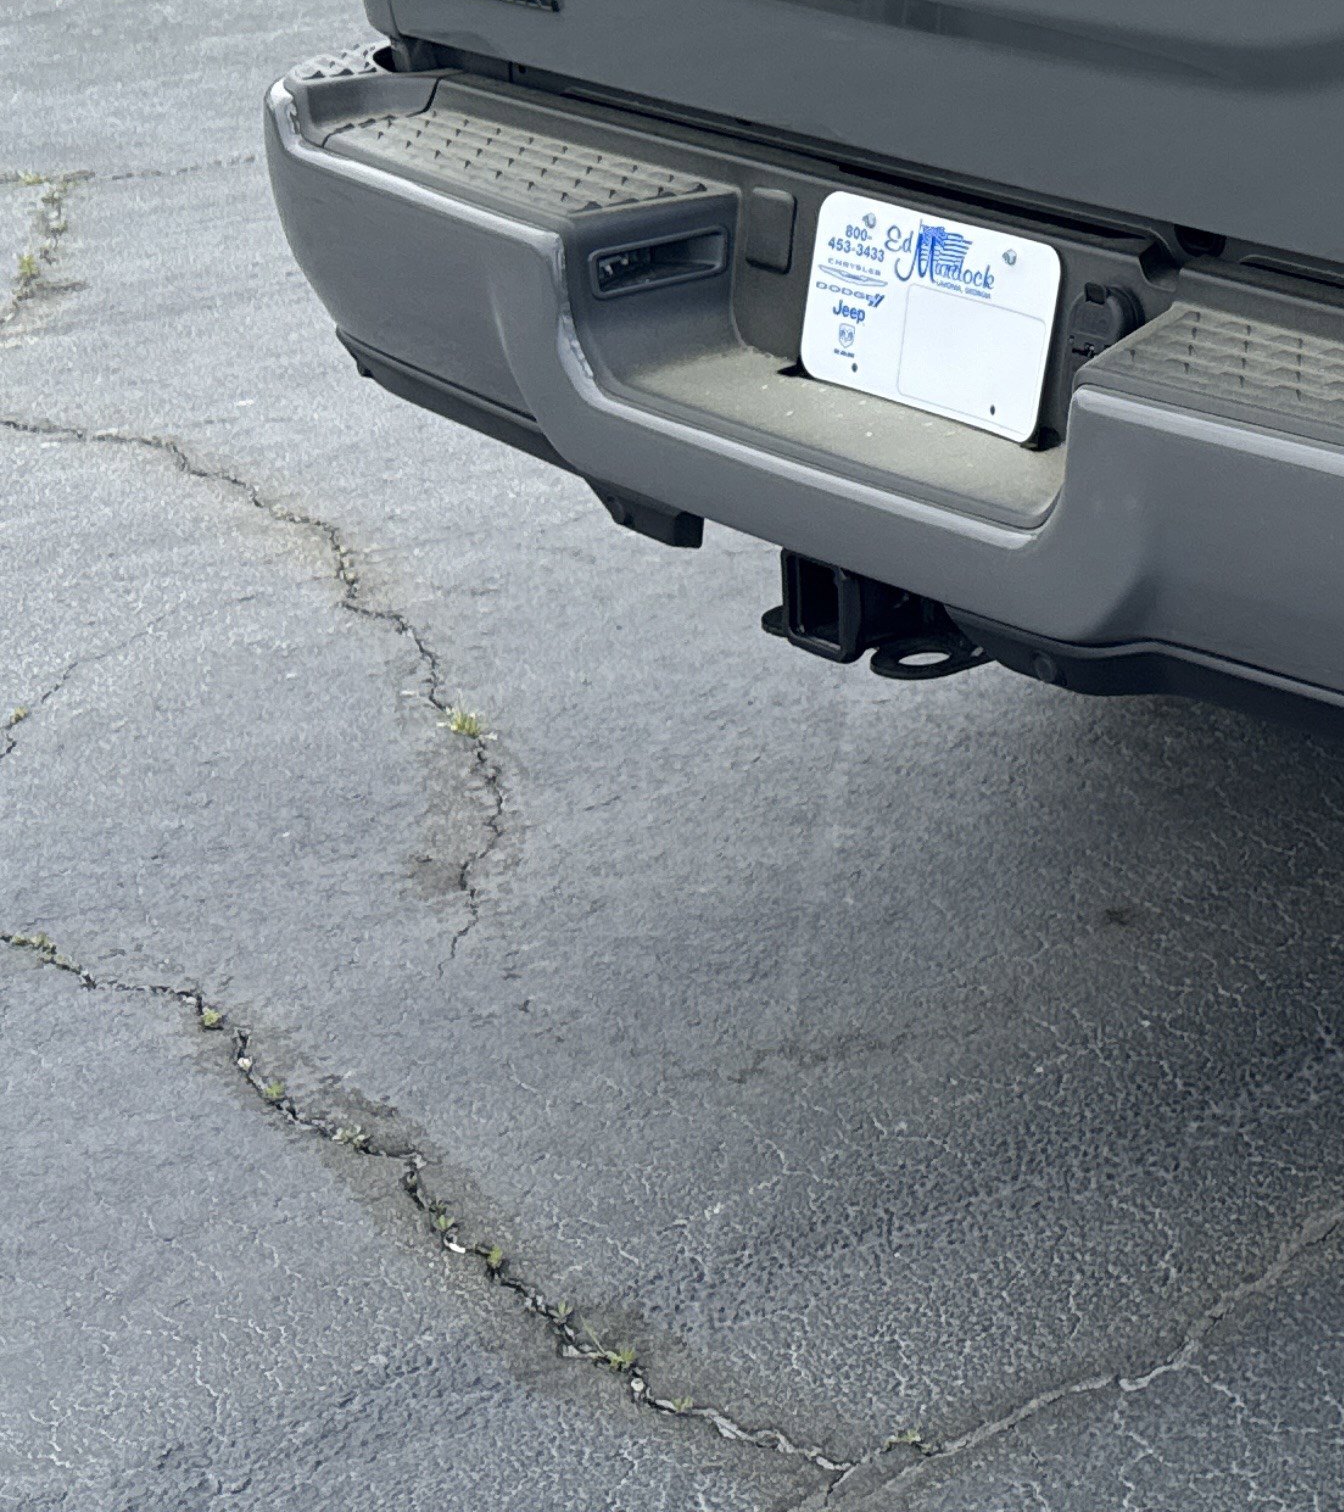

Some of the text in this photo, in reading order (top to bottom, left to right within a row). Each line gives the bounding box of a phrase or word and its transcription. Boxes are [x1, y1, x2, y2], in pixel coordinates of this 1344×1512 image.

[828, 236, 885, 263] 453-3433
[883, 224, 915, 254] Ed
[832, 299, 866, 325] Jeep
